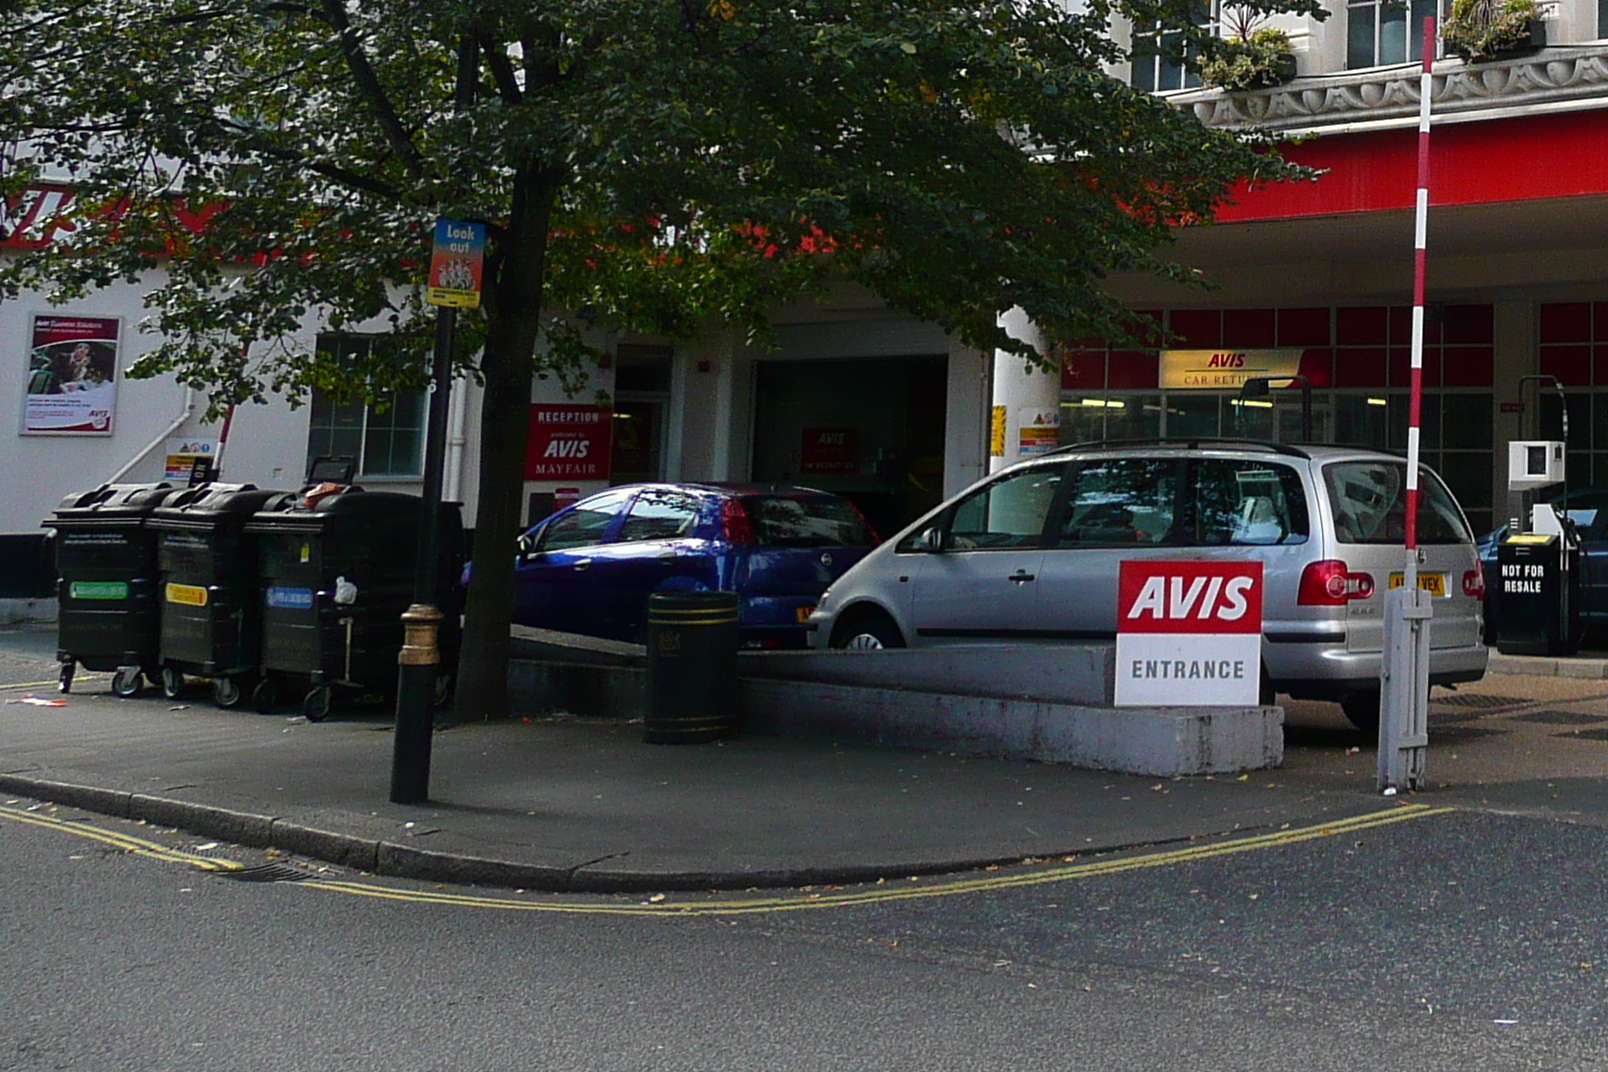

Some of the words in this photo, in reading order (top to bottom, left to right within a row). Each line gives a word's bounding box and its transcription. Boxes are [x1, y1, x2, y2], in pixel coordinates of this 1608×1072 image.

[447, 224, 475, 240] Look
[450, 242, 470, 253] out
[1208, 353, 1246, 367] AVIS
[1184, 375, 1208, 385] CAR
[538, 411, 599, 423] RECEPTION
[543, 439, 590, 458] AVIS
[536, 463, 596, 475] MAYFAIR
[1502, 564, 1521, 577] NOT
[1524, 564, 1544, 577] FOR
[1504, 580, 1541, 593] RESALE
[1127, 576, 1254, 621] AVIS
[1132, 660, 1244, 679] ENTRANCE
